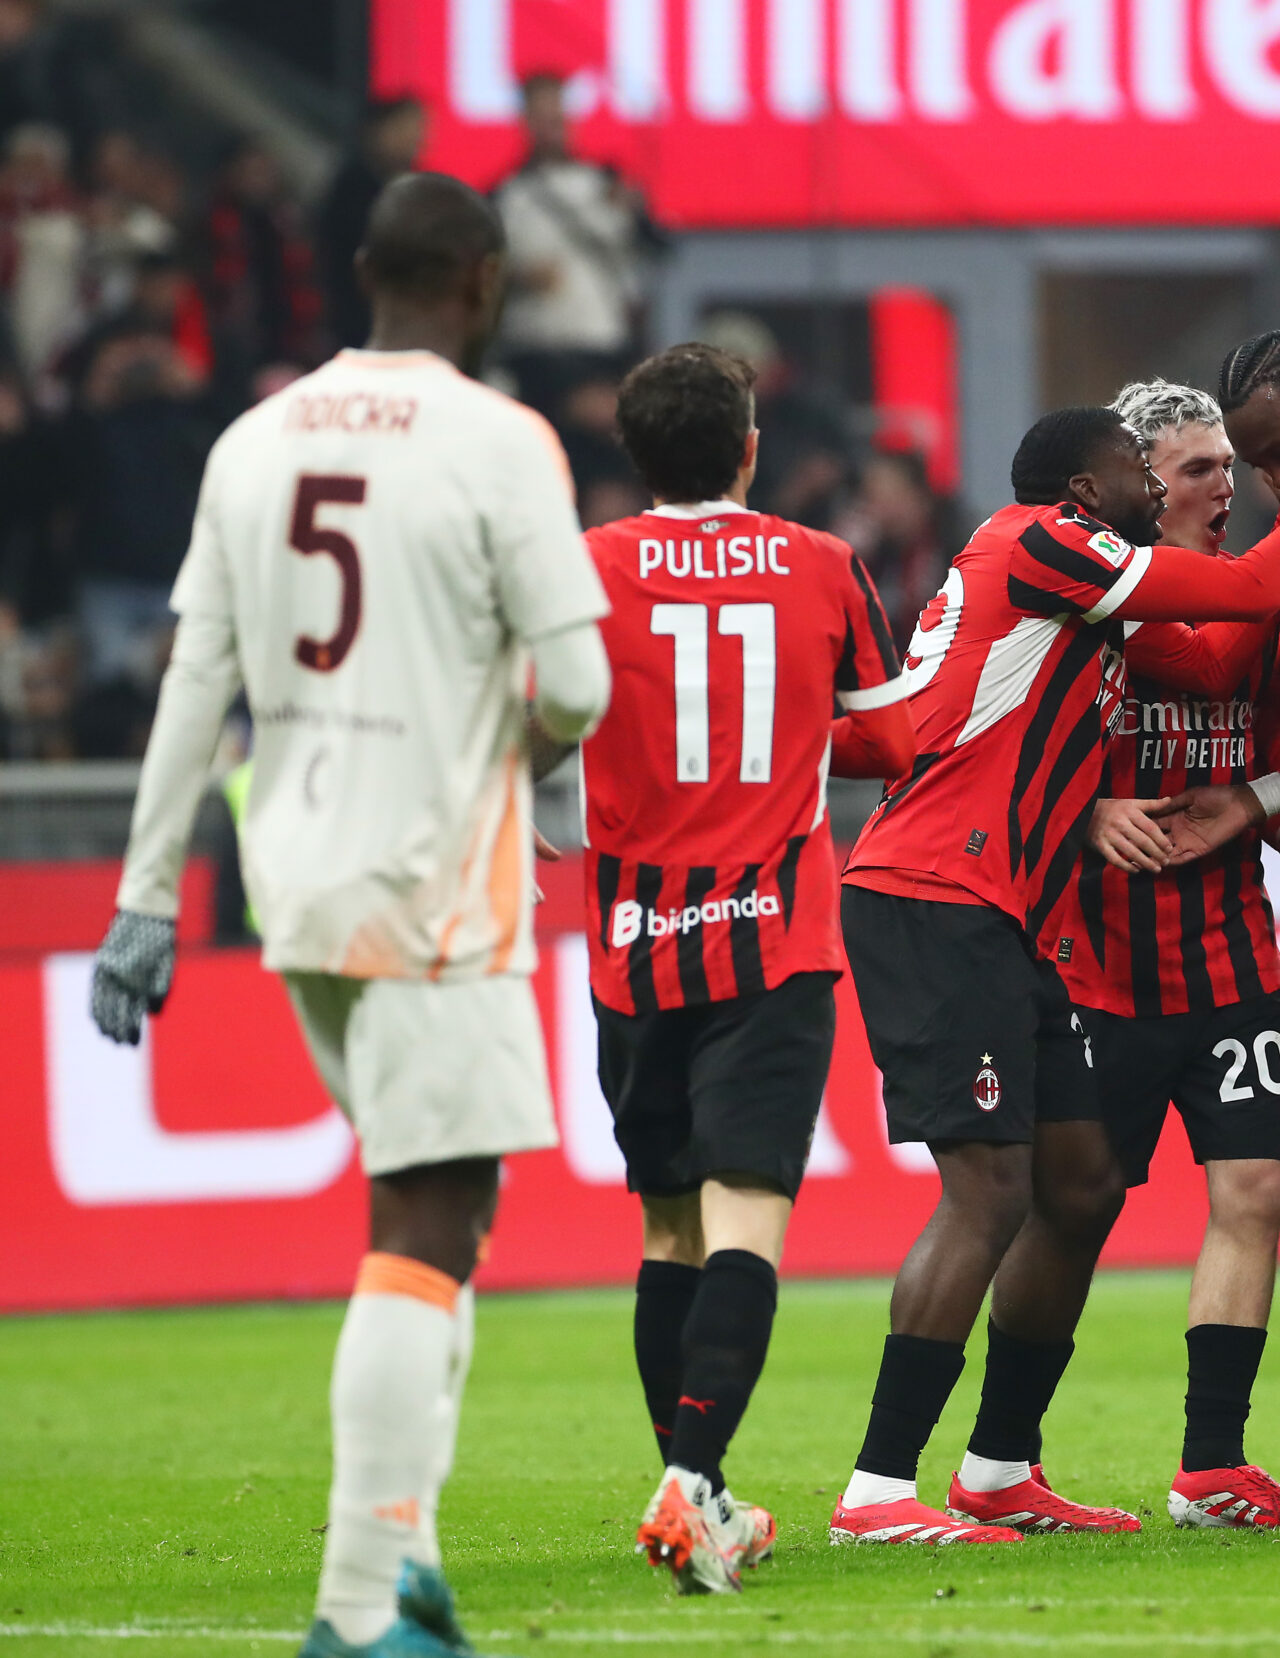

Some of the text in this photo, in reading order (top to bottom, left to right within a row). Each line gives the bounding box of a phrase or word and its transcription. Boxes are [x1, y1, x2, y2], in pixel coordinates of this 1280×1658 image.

[289, 473, 367, 674] 5
[639, 535, 790, 579] PULISIC
[650, 602, 776, 783] 11
[1140, 737, 1245, 769] FLY BETTER
